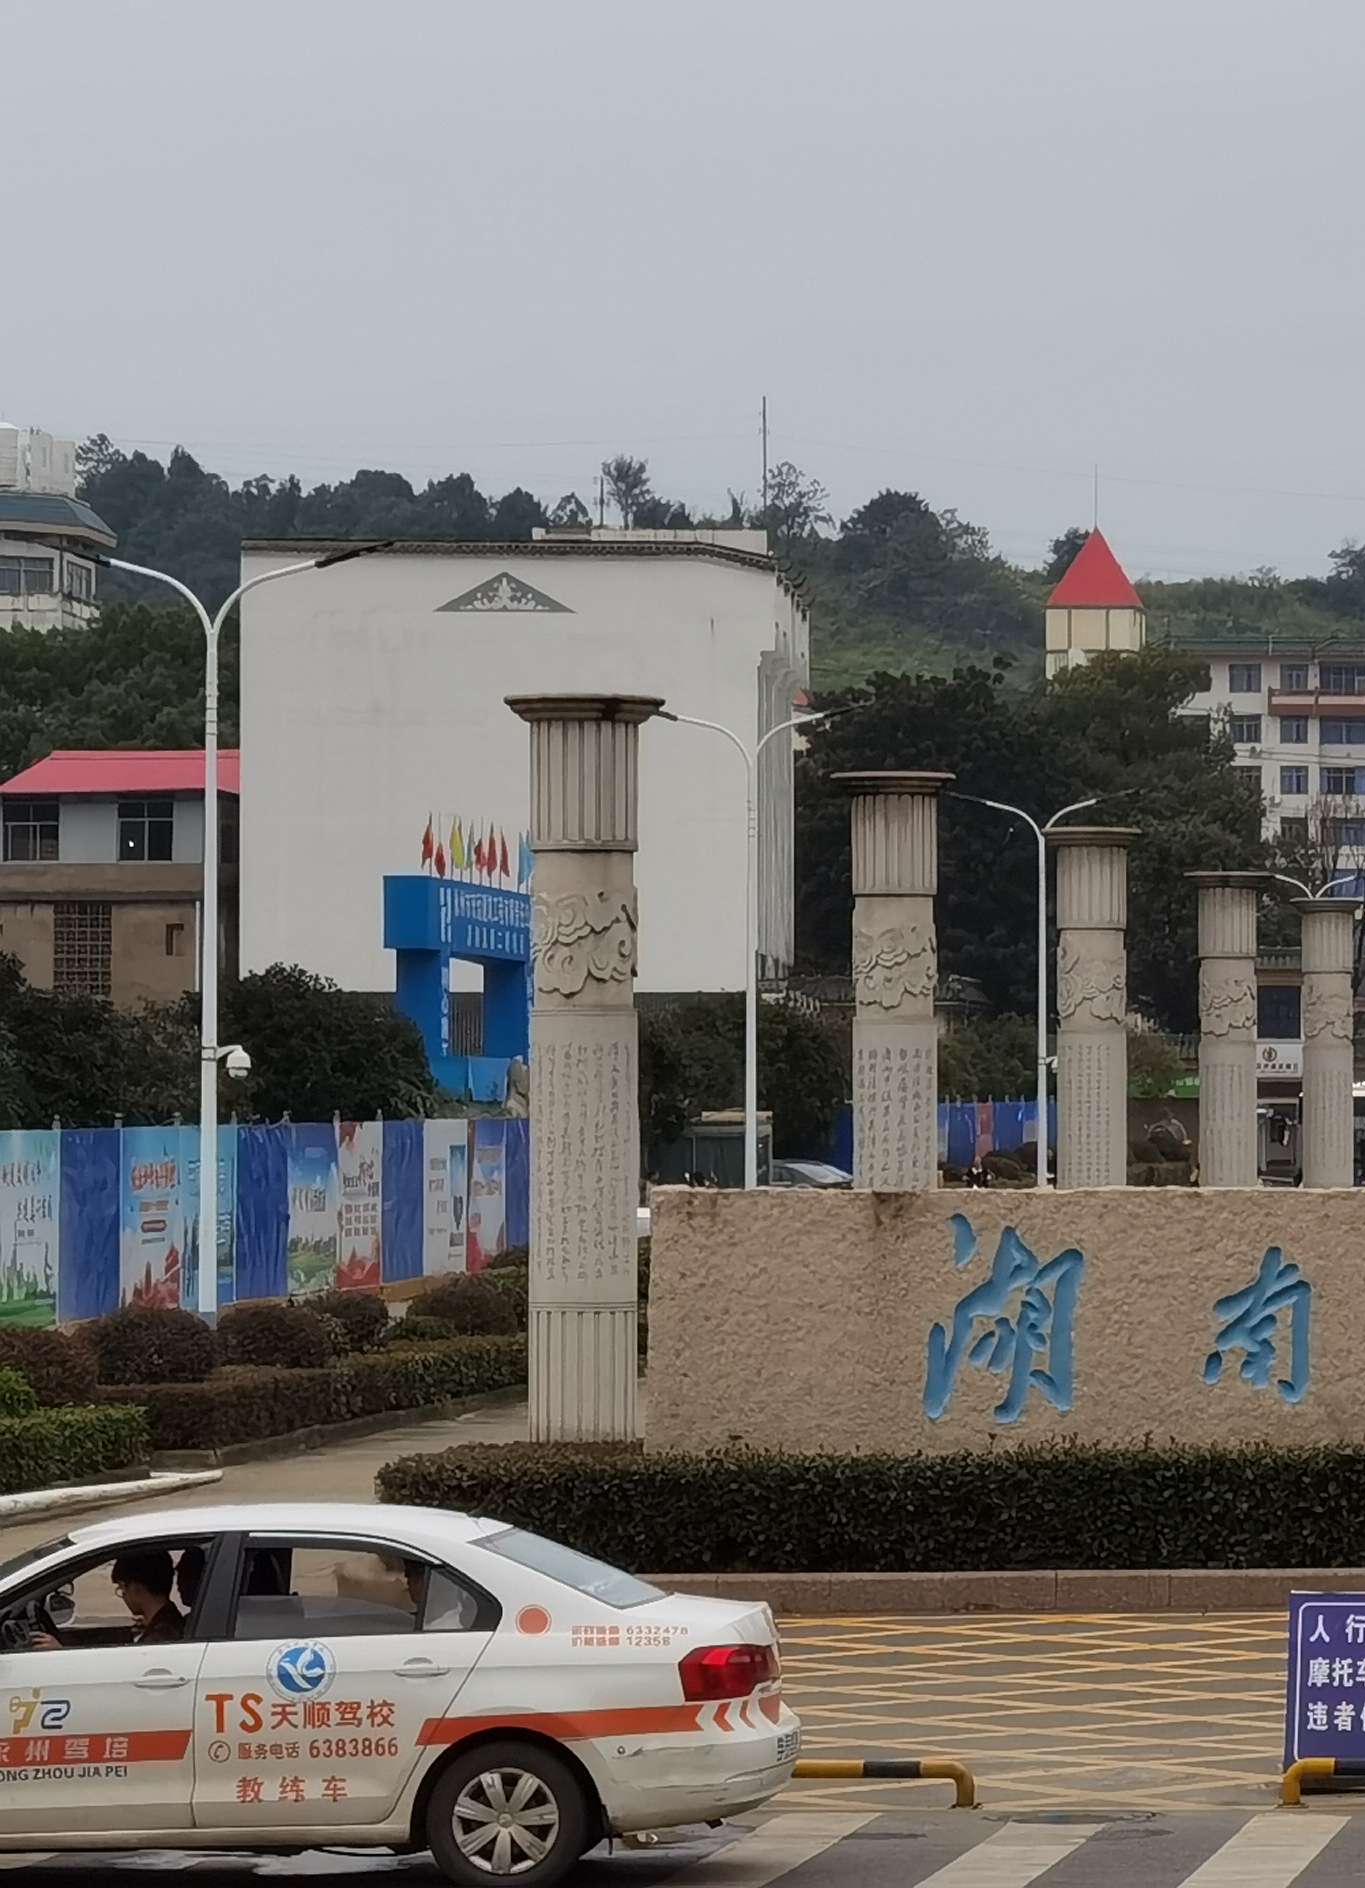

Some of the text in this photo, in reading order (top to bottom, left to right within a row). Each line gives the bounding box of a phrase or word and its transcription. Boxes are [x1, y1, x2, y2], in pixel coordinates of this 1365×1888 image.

[205, 1693, 396, 1734] TS 天顺驾校
[237, 1737, 399, 1760] 服务电话 6383866
[33, 1767, 75, 1781] ZHOU
[77, 1766, 101, 1778] JIA
[105, 1765, 128, 1778] PEI
[236, 1776, 348, 1803] 教练车
